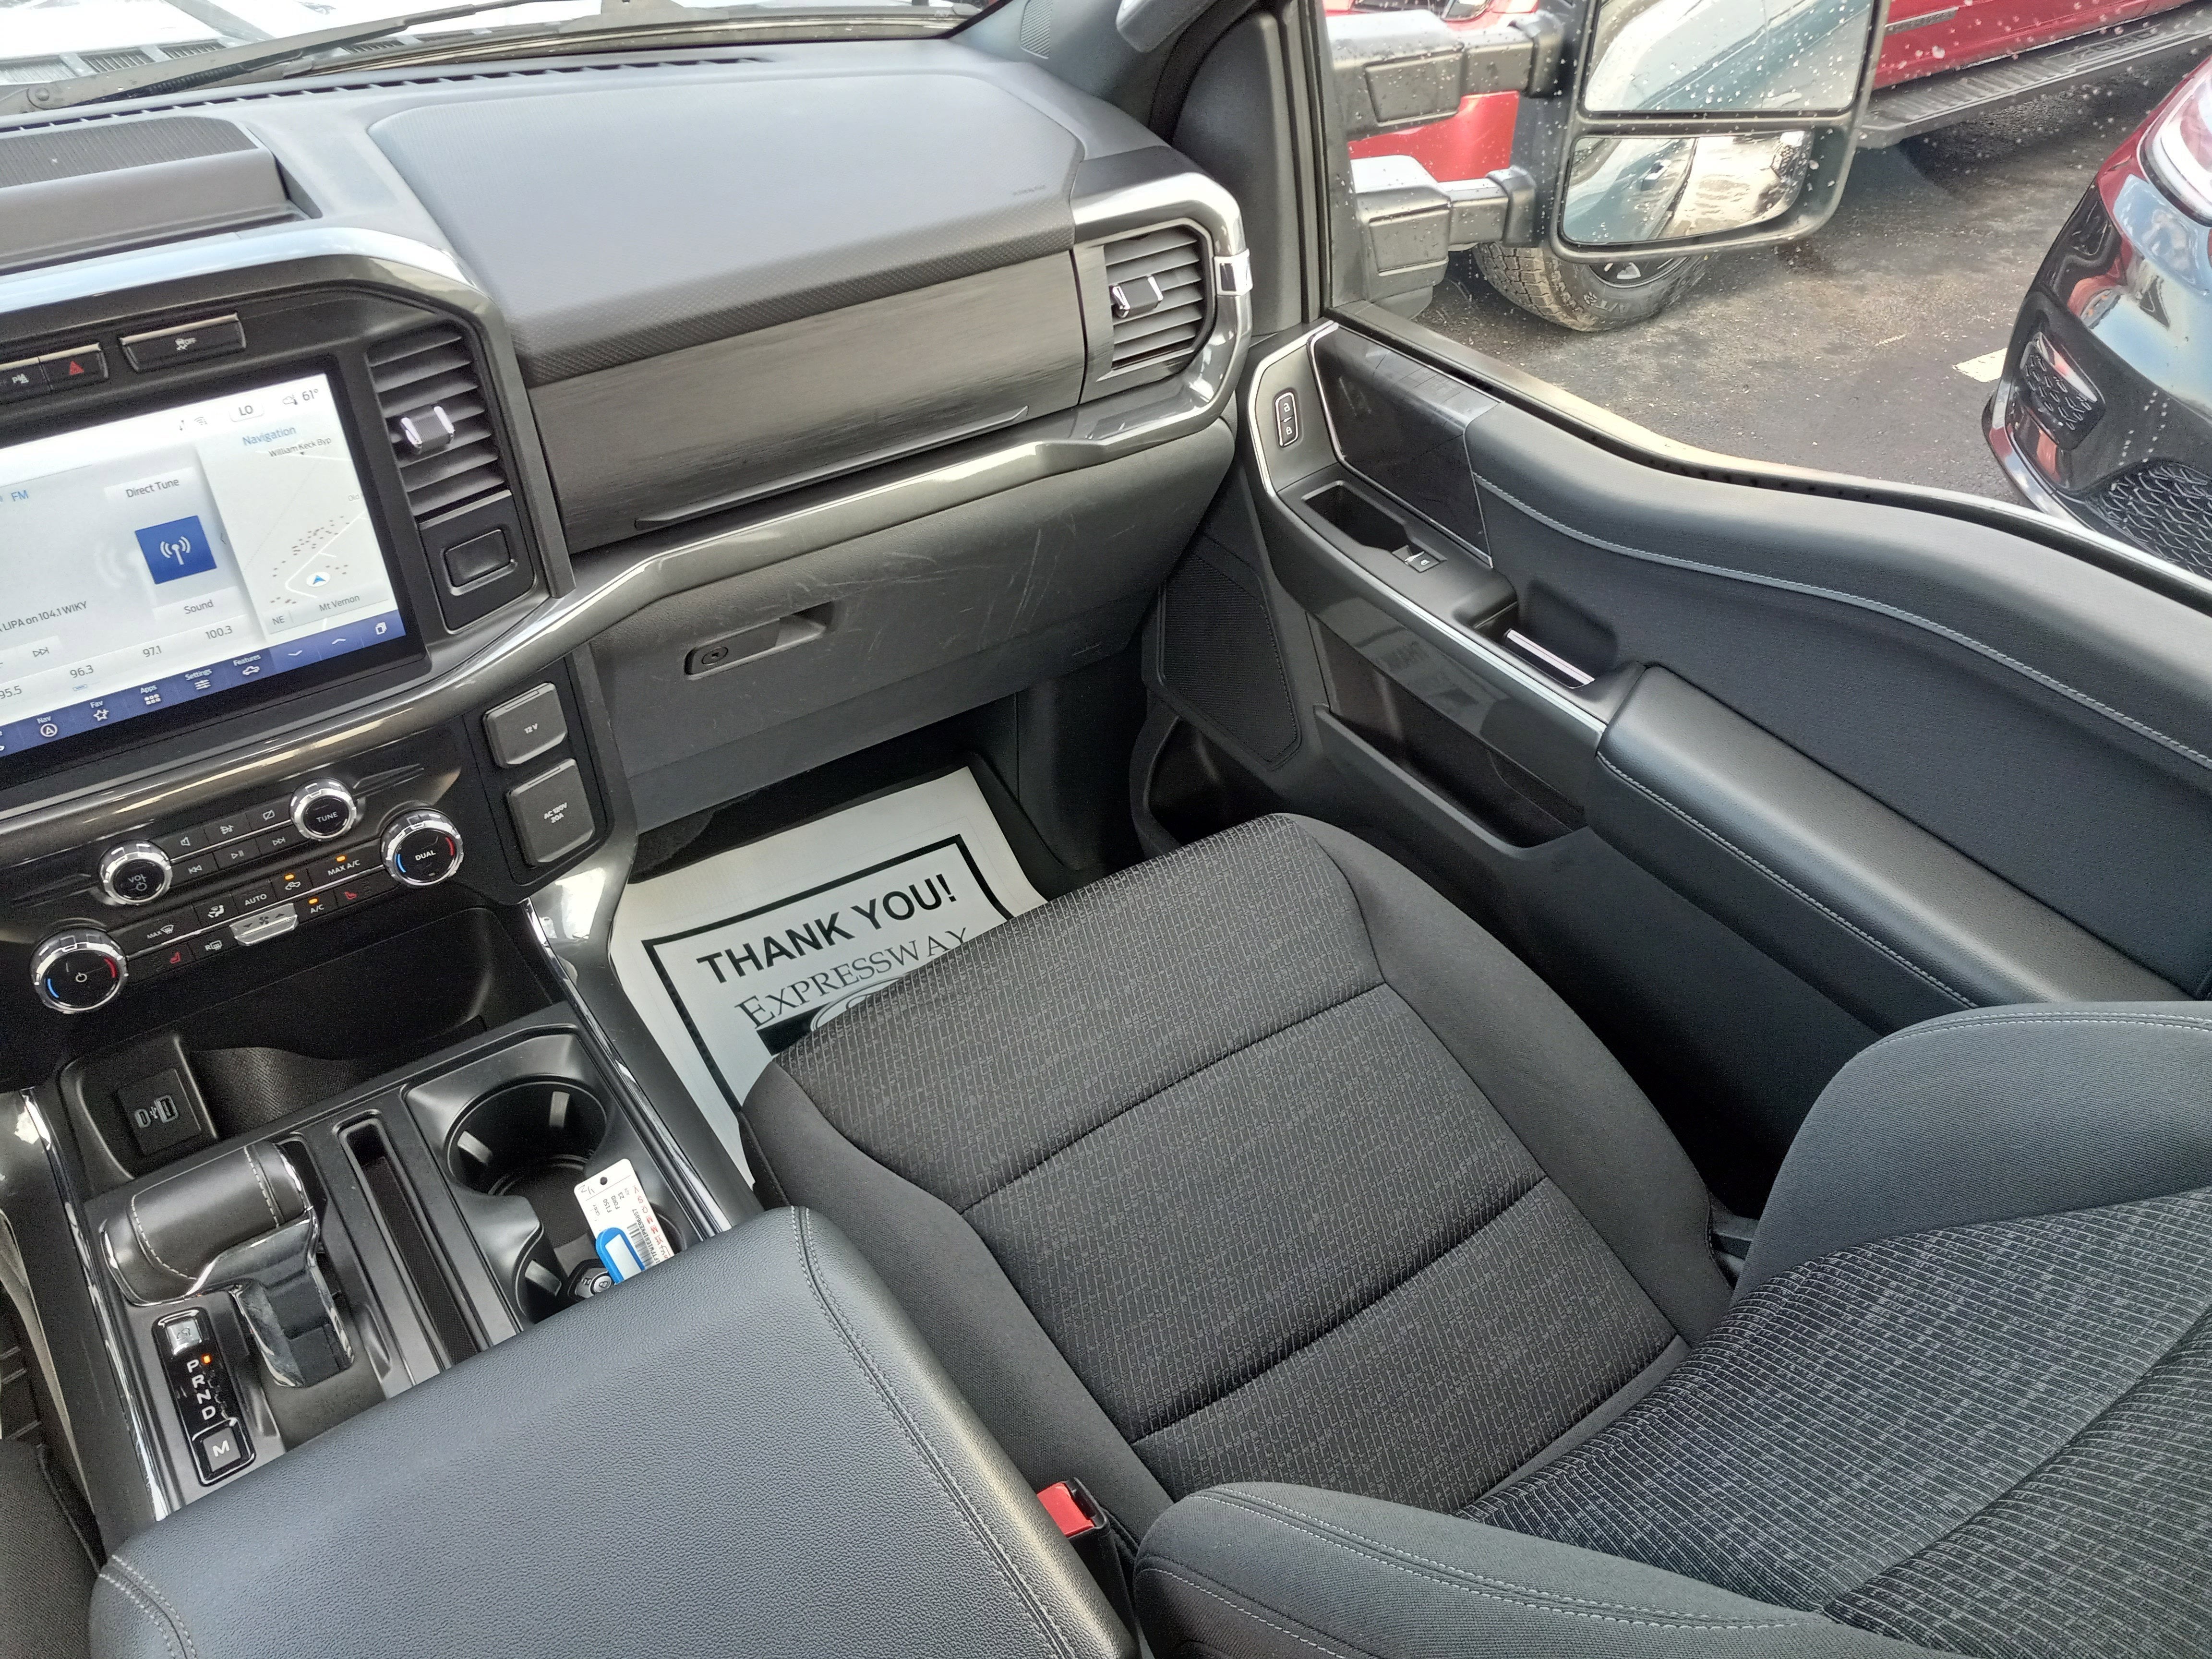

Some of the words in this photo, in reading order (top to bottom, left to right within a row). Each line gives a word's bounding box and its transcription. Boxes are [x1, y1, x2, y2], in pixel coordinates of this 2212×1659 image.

[238, 405, 254, 416] LO
[242, 426, 297, 446] Navigation
[268, 445, 299, 457] William
[298, 441, 317, 450] Keck
[317, 438, 332, 446] Byp
[11, 489, 29, 502] FM
[125, 484, 155, 498] Direct
[155, 479, 180, 491] Tune
[184, 600, 215, 614] Sound
[319, 602, 331, 612] Mt
[331, 594, 361, 608] Vernon
[2, 618, 25, 631] LIPA
[25, 616, 39, 625] on
[38, 608, 62, 621] 104.1
[61, 601, 87, 614] WIKY
[272, 615, 285, 626] NE
[0, 685, 22, 699] 95.5
[70, 664, 94, 678] 96.3
[143, 645, 162, 658] 97.1
[204, 625, 233, 639] 100.3
[233, 654, 262, 666] Features
[185, 669, 213, 681] Settings
[140, 685, 158, 694] Apps
[89, 700, 104, 709] Fav
[36, 715, 52, 724] Nav
[315, 811, 338, 823] TUNE
[544, 811, 553, 819] AC
[552, 802, 567, 814] 120V
[551, 813, 564, 823] 20A
[414, 850, 436, 861] DUAL
[327, 865, 347, 876] MAX
[346, 859, 361, 869] A/C
[244, 893, 267, 906] AUTO
[310, 904, 325, 914] A/C
[146, 930, 162, 939] MAX
[697, 912, 855, 984] THANK
[850, 873, 958, 930] YOU!
[734, 927, 970, 1028] EXPRESSWAY
[603, 1199, 612, 1213] F150
[611, 1195, 620, 1210] FORD
[632, 1209, 661, 1263] 1FTFW1E81PKE96857
[187, 1359, 199, 1373] P
[192, 1375, 205, 1388] R
[196, 1389, 211, 1404] N
[202, 1406, 216, 1420] D
[212, 1440, 230, 1457] M
